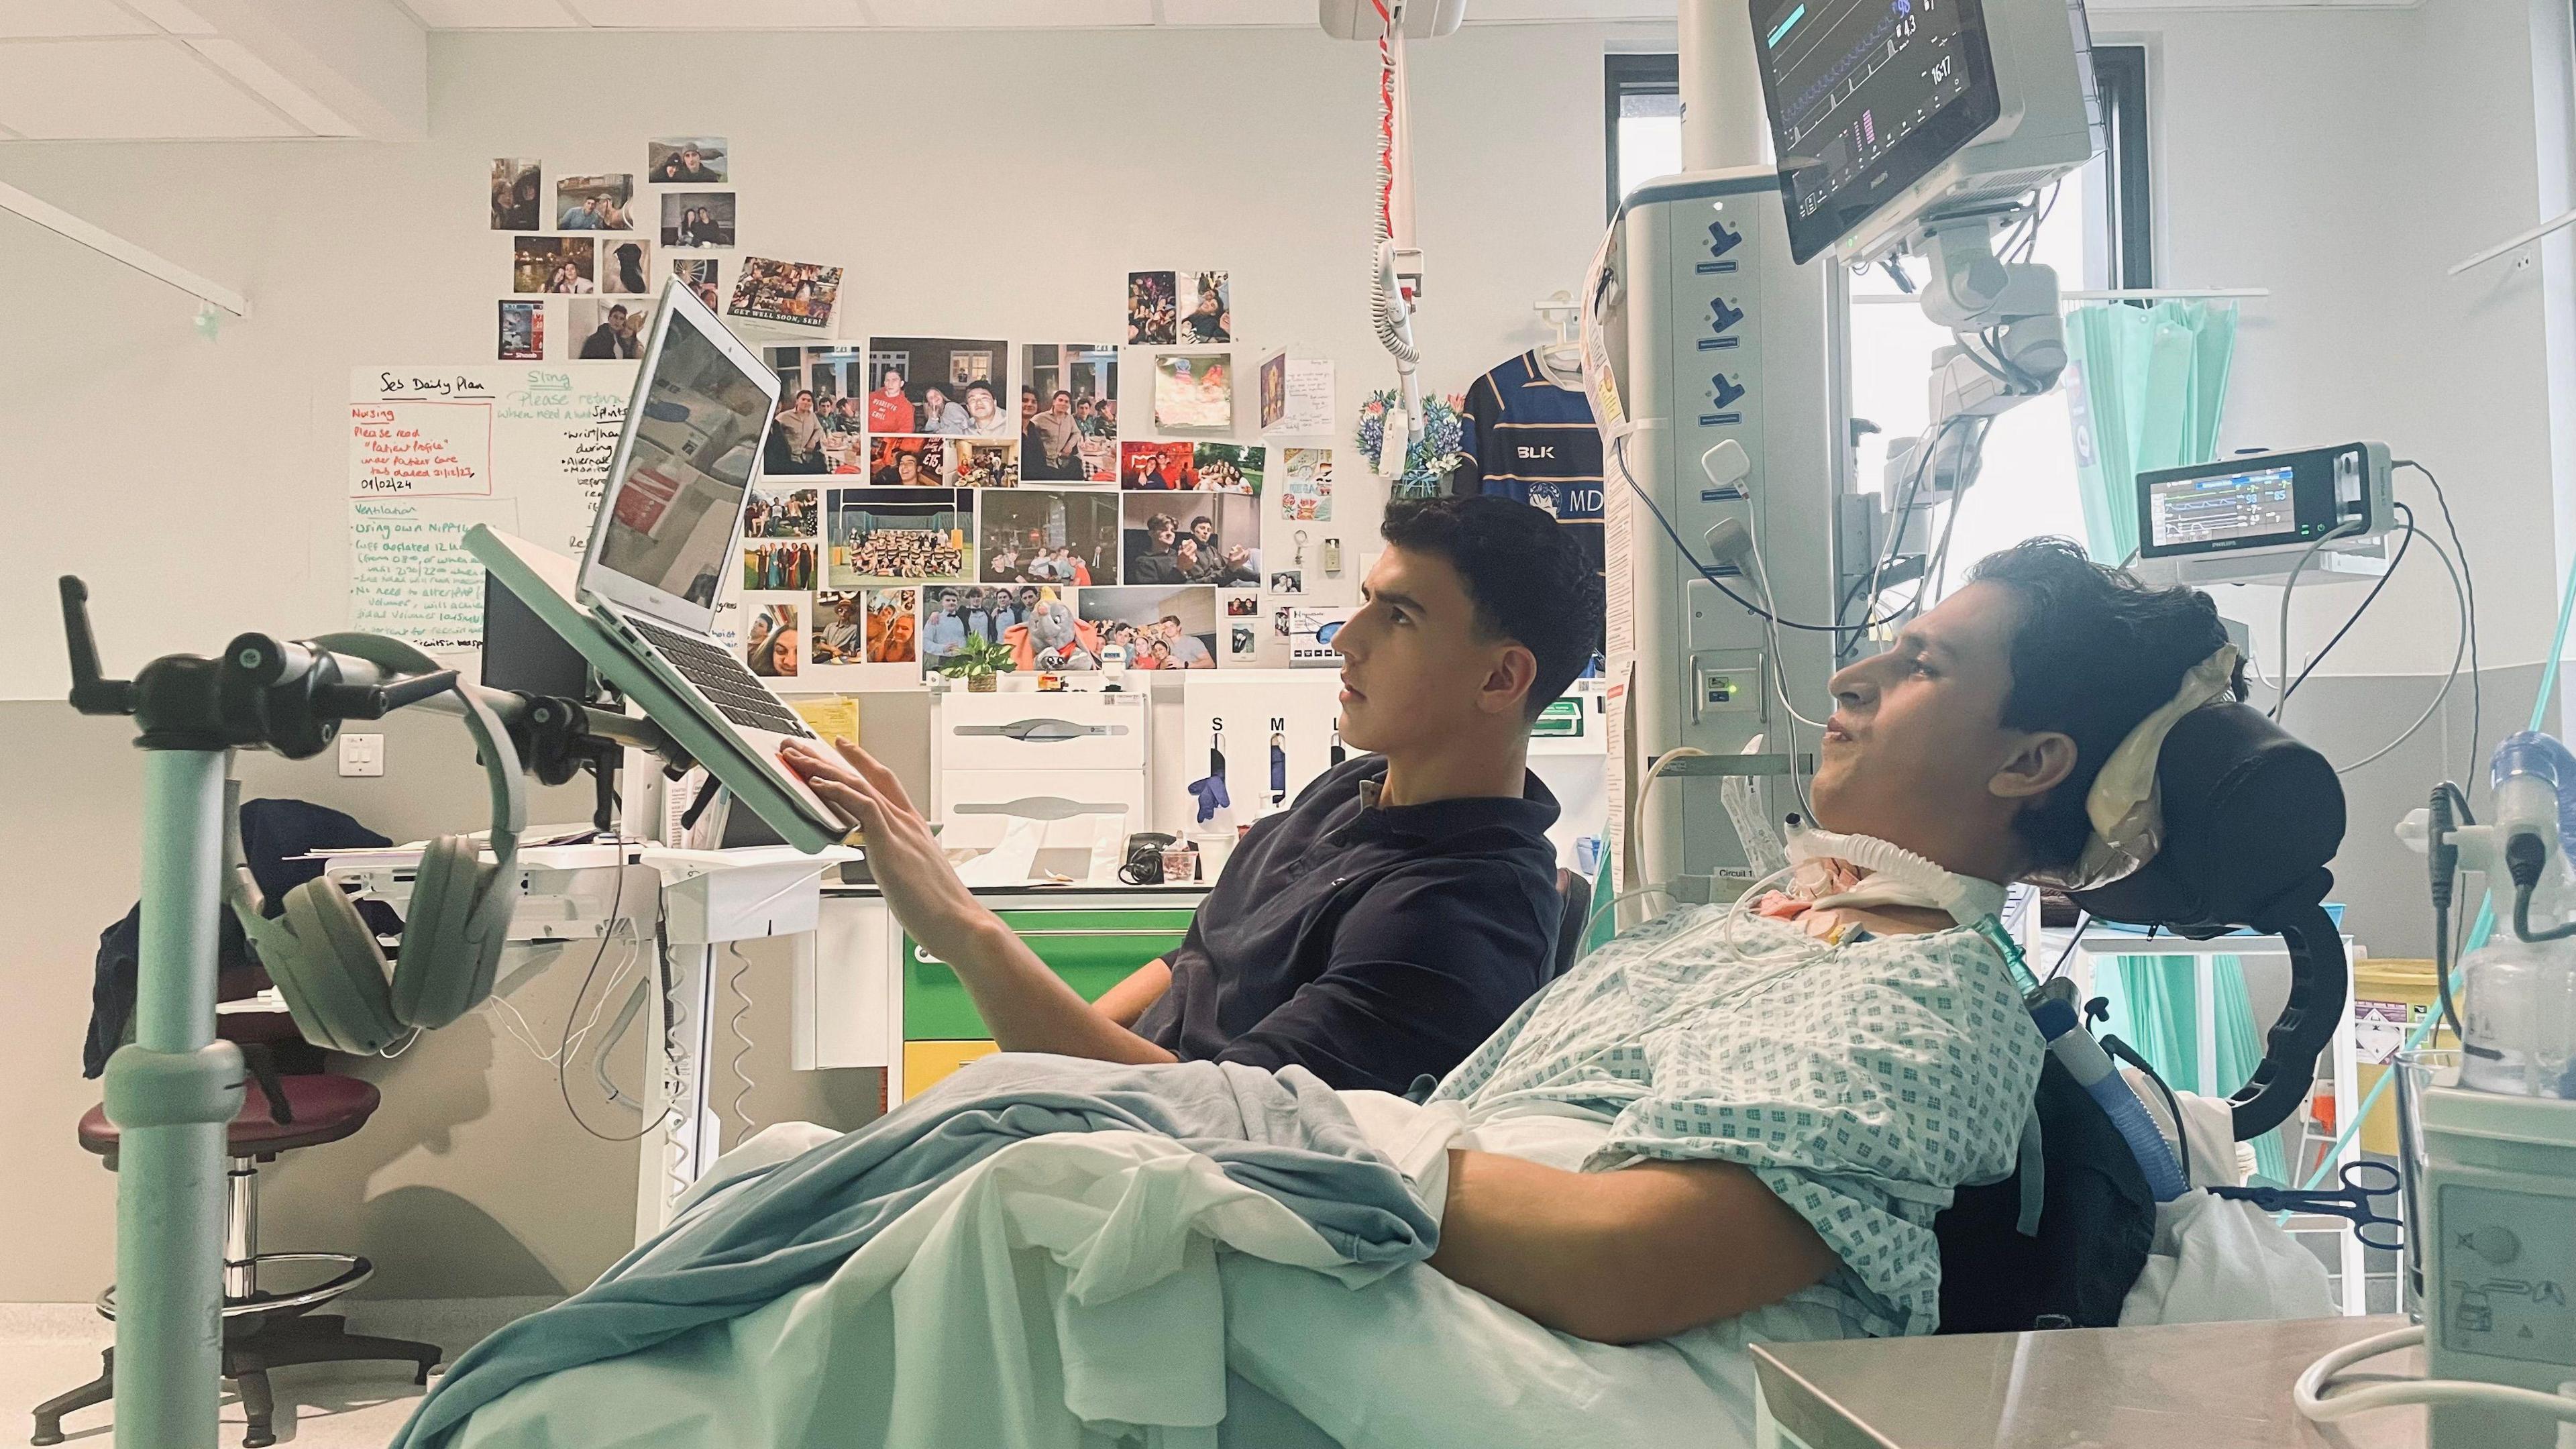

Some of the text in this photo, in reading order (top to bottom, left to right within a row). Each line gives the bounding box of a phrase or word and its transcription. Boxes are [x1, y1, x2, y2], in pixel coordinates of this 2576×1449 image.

[1932, 55, 1951, 85] 16:17
[753, 311, 773, 319] WELL
[777, 313, 800, 323] SOON,
[803, 317, 822, 325] SEB!
[380, 372, 484, 394] Seb Daily Plan
[527, 370, 570, 389] Sling
[507, 391, 569, 407] Please
[352, 407, 394, 421] Nursing
[537, 409, 560, 419] need
[592, 405, 629, 419] Splints
[354, 426, 420, 437] Please read
[576, 442, 612, 458] during
[1517, 446, 1555, 460] BLK
[922, 453, 941, 468] £15
[394, 468, 430, 478] dated
[1569, 490, 1605, 512] MD
[355, 503, 417, 515] Ventilation
[356, 521, 392, 540] Using
[394, 525, 423, 533] own
[382, 542, 430, 552] deflated
[1212, 717, 1223, 731] S
[1271, 717, 1285, 731] M
[1719, 869, 1746, 877] Circuit
